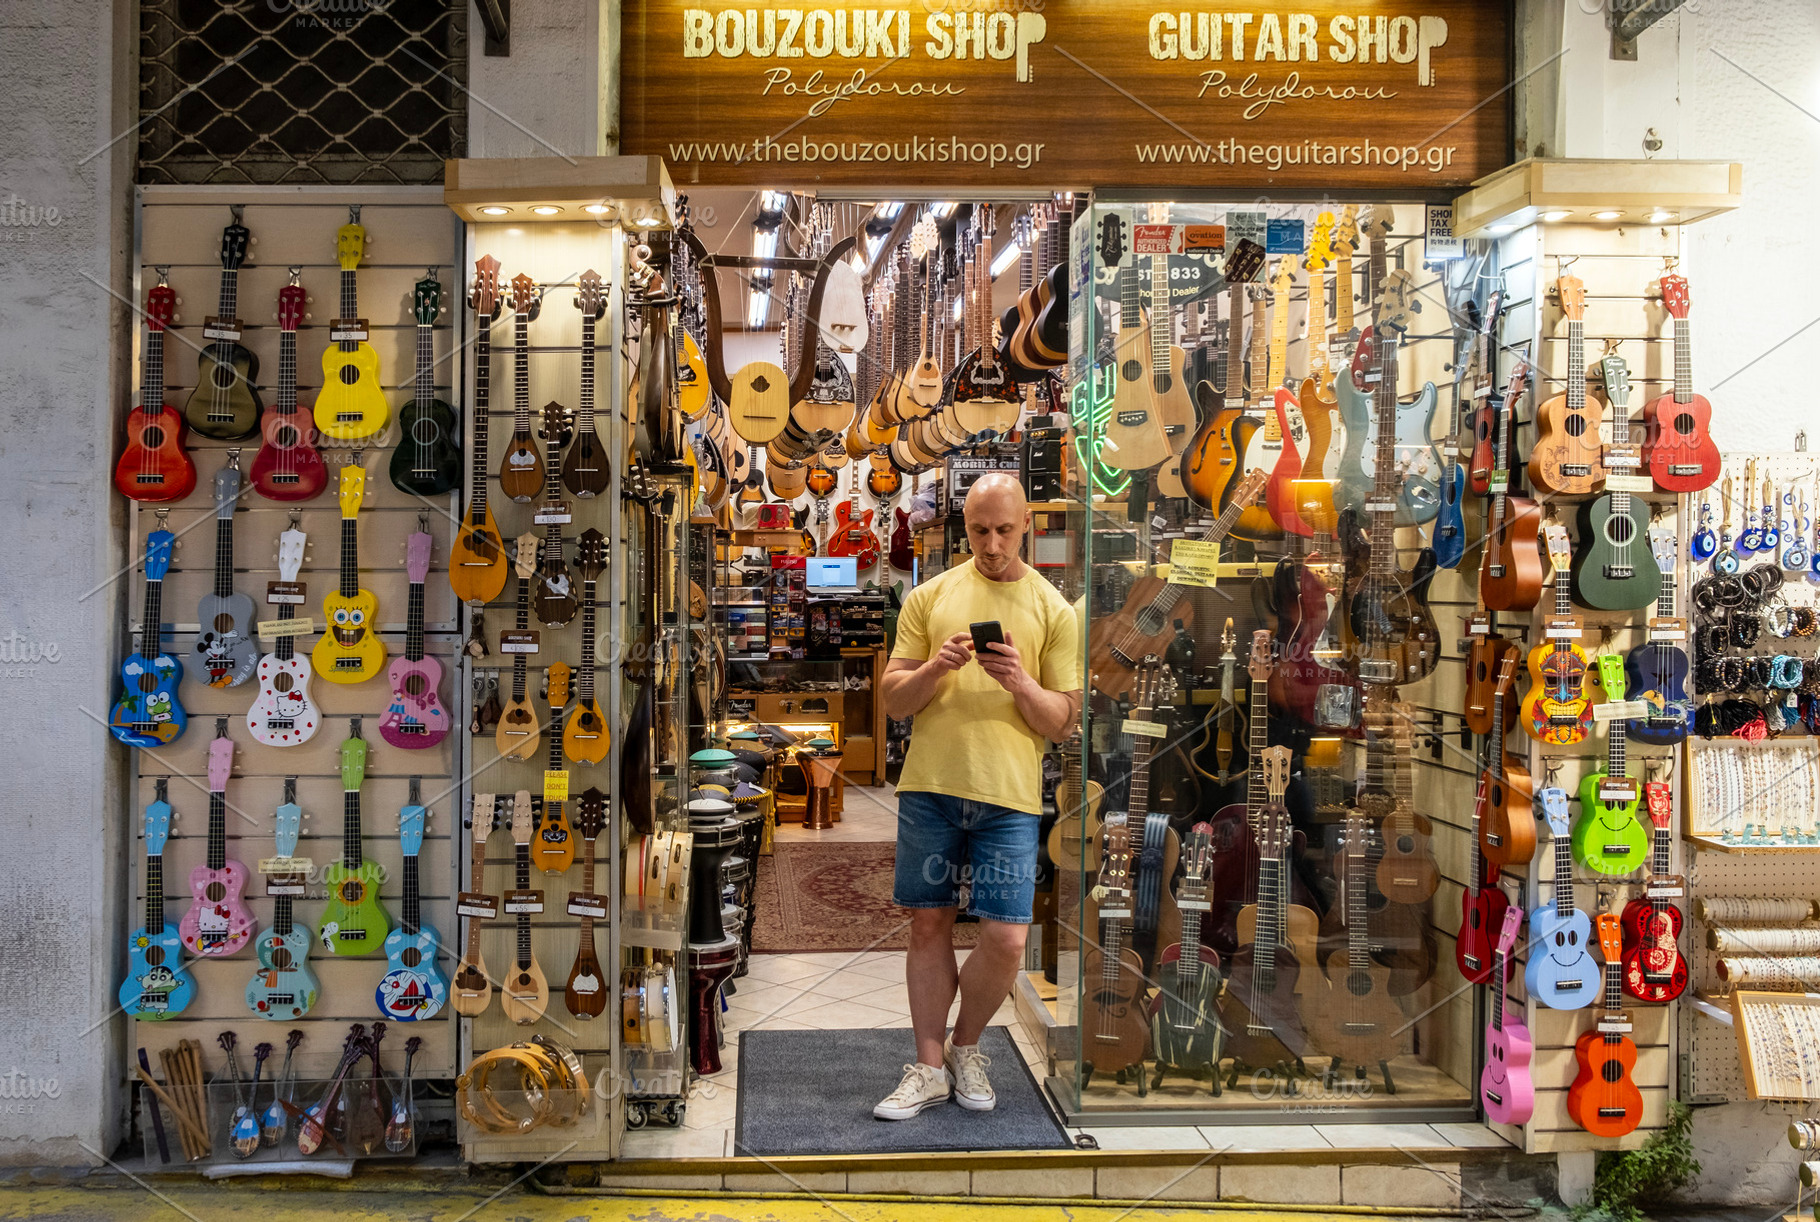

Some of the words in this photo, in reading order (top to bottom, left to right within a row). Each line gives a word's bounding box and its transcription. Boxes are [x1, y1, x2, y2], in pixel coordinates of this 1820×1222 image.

[683, 9, 910, 59] BOUZOUKI
[925, 10, 1046, 83] SHOP
[1148, 12, 1318, 63] GUITAR
[1328, 14, 1449, 87] SHOP
[762, 68, 965, 118] Polydorou
[1198, 69, 1398, 120] Polydorou
[668, 136, 1045, 169] www.thebouzoukishop.gr
[1135, 138, 1456, 172] www.theguitarshop.gr
[1431, 219, 1448, 227] TAX
[1135, 226, 1166, 237] Fender
[1190, 231, 1223, 239] ovation
[1430, 228, 1452, 237] FREE
[1137, 244, 1167, 252] DEALER
[1168, 267, 1201, 280] 833
[1172, 286, 1200, 297] Dealer
[952, 461, 997, 469] MOBILE
